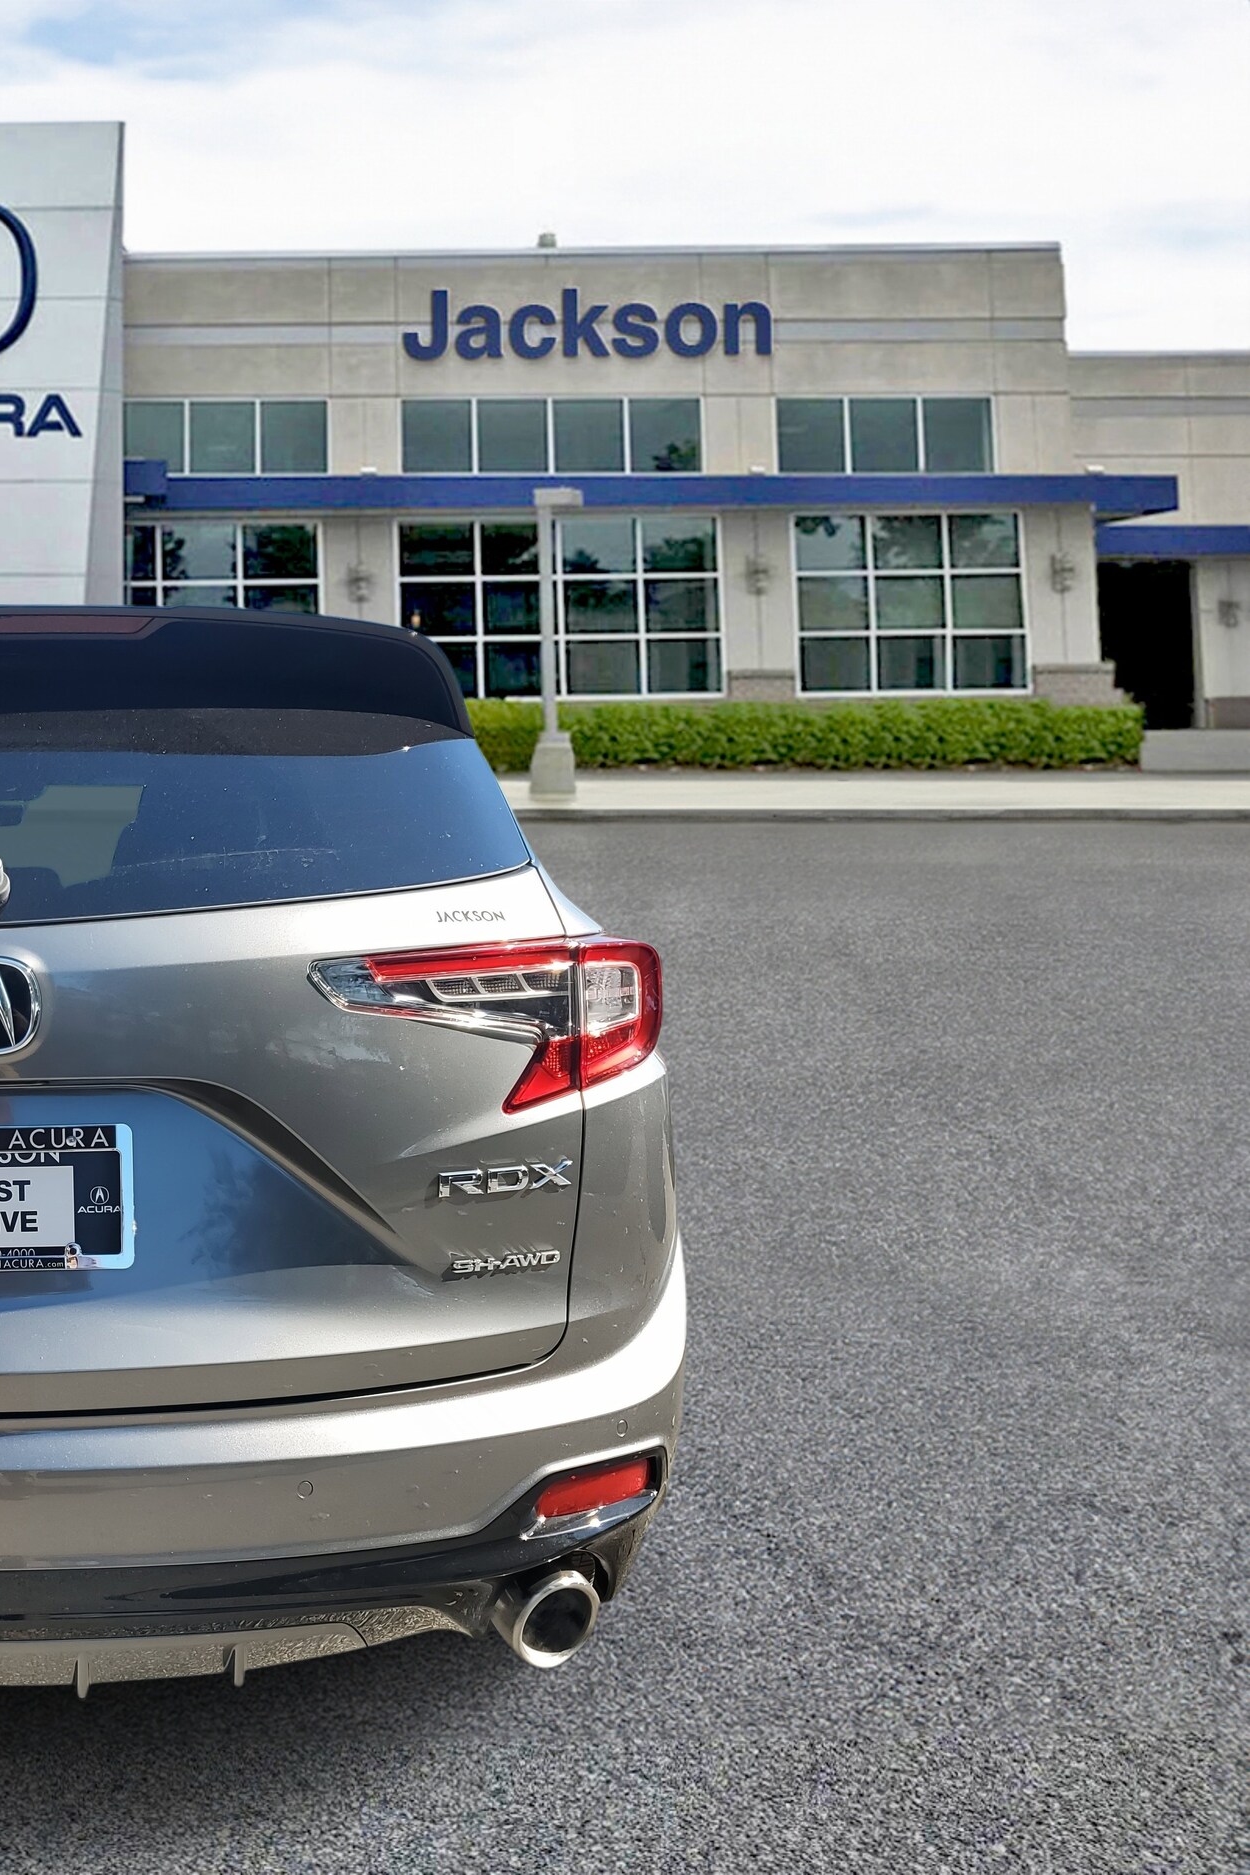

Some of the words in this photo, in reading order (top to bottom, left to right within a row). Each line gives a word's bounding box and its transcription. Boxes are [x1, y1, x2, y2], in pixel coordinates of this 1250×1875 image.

[402, 288, 773, 361] Jackson
[436, 910, 506, 923] JACKSON
[8, 1127, 109, 1150] ACURA
[438, 1157, 573, 1198] RDX
[77, 1205, 121, 1214] ACURA
[452, 1250, 561, 1274] SH-AWD
